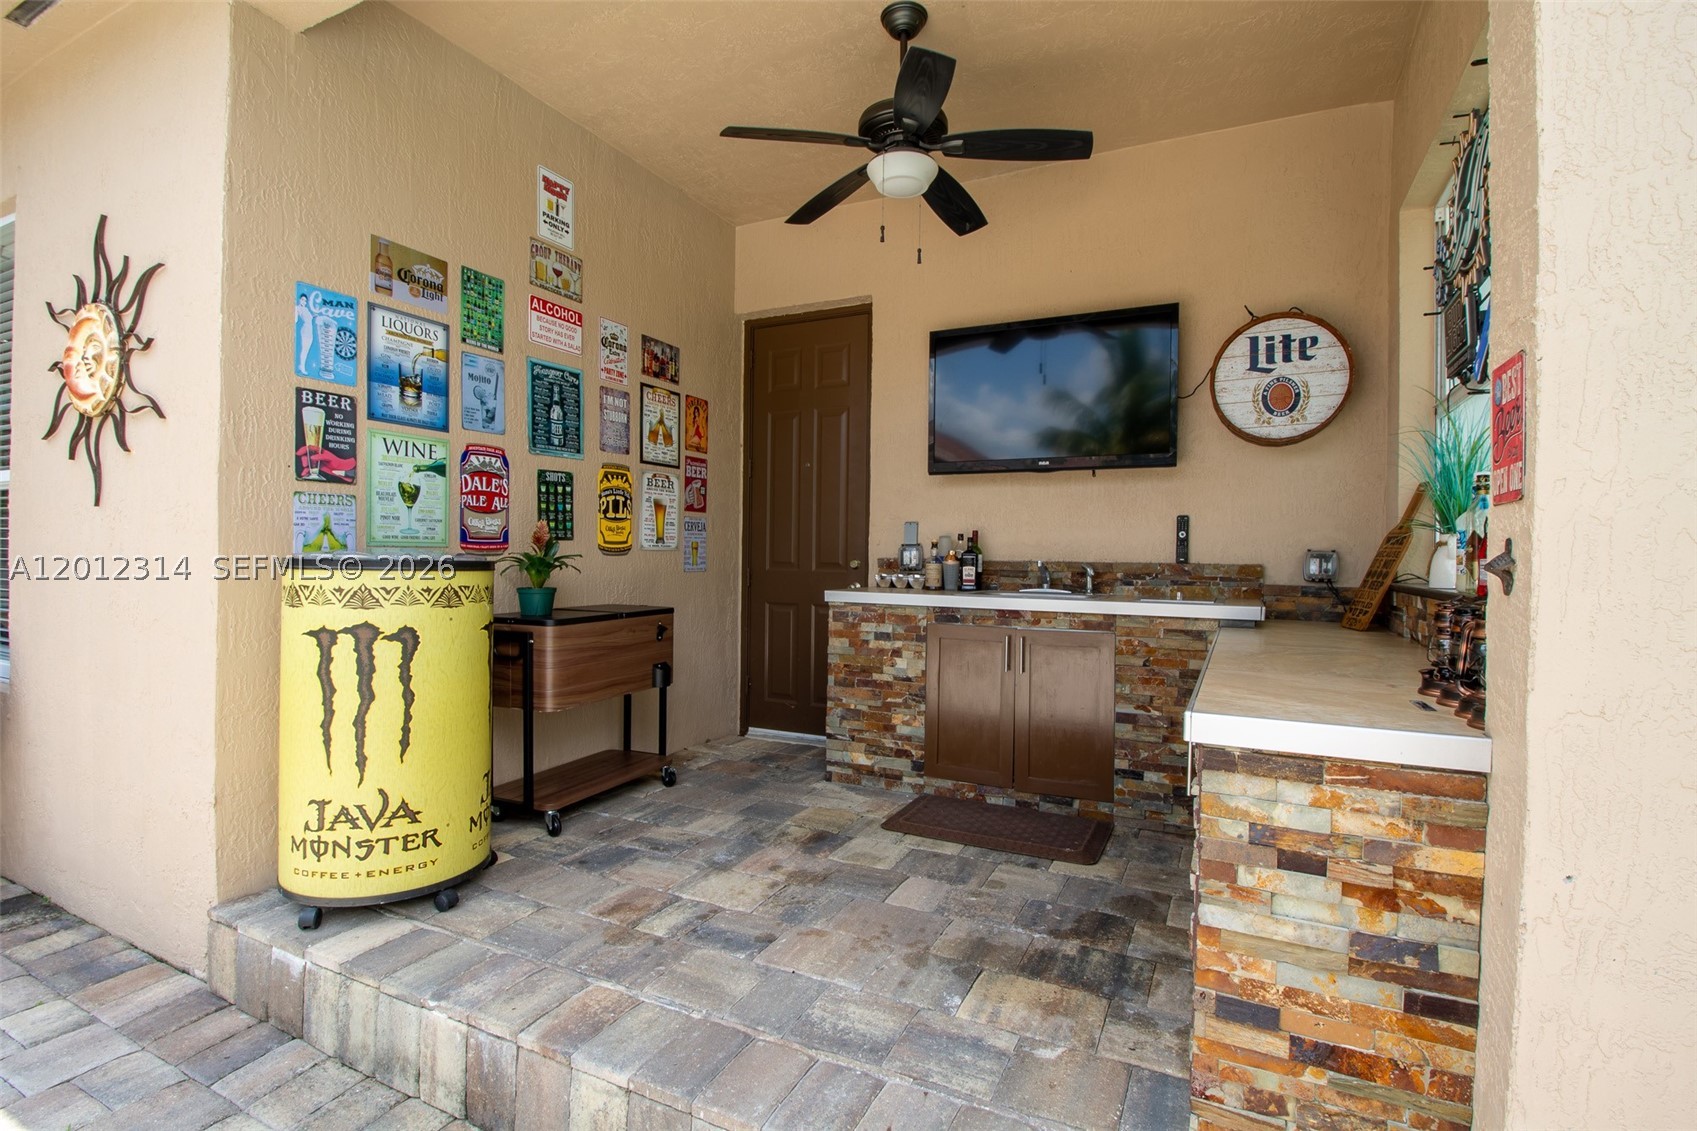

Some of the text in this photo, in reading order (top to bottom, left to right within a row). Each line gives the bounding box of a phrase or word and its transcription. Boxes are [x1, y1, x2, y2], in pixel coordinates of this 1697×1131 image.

[542, 210, 570, 229] PARKING
[548, 220, 565, 233] ONLY
[554, 250, 581, 276] THERAPY
[397, 267, 444, 293] Corona
[420, 286, 444, 302] Light
[309, 290, 355, 320] Cave
[321, 298, 355, 310] MAN
[531, 298, 581, 326] ALCOHOL
[382, 315, 439, 342] LIQUORS
[536, 314, 578, 335] BECAUSE NO GOOD
[539, 324, 575, 342] STORY HAS EVER
[532, 331, 553, 344] STARTED
[553, 336, 564, 346] WITH
[564, 338, 568, 347] A
[601, 336, 627, 353] Corona
[1245, 334, 1319, 374] Lite
[467, 372, 492, 385] Mojito
[1265, 379, 1278, 391] FINE
[1280, 377, 1300, 394] PILSNER
[1502, 361, 1522, 406] BEST
[301, 390, 352, 411] BEER
[646, 391, 677, 408] CHEERS
[325, 419, 355, 429] WORKING
[328, 427, 352, 436] DURING
[325, 434, 356, 444] DRINKING
[328, 442, 350, 450] HOURS
[382, 437, 438, 461] WINE
[545, 471, 566, 483] SHOTS
[686, 465, 707, 479] BEER
[1493, 465, 1509, 497] OPEN
[461, 474, 509, 496] DALE'S
[646, 477, 675, 490] BEER
[298, 492, 353, 507] CHEERS
[461, 494, 487, 509] PALE
[600, 495, 632, 519] PILS
[304, 788, 424, 834] JAVA
[291, 828, 443, 863] MONSTER
[293, 867, 350, 880] COFFEE
[366, 858, 439, 878] ENERGY
